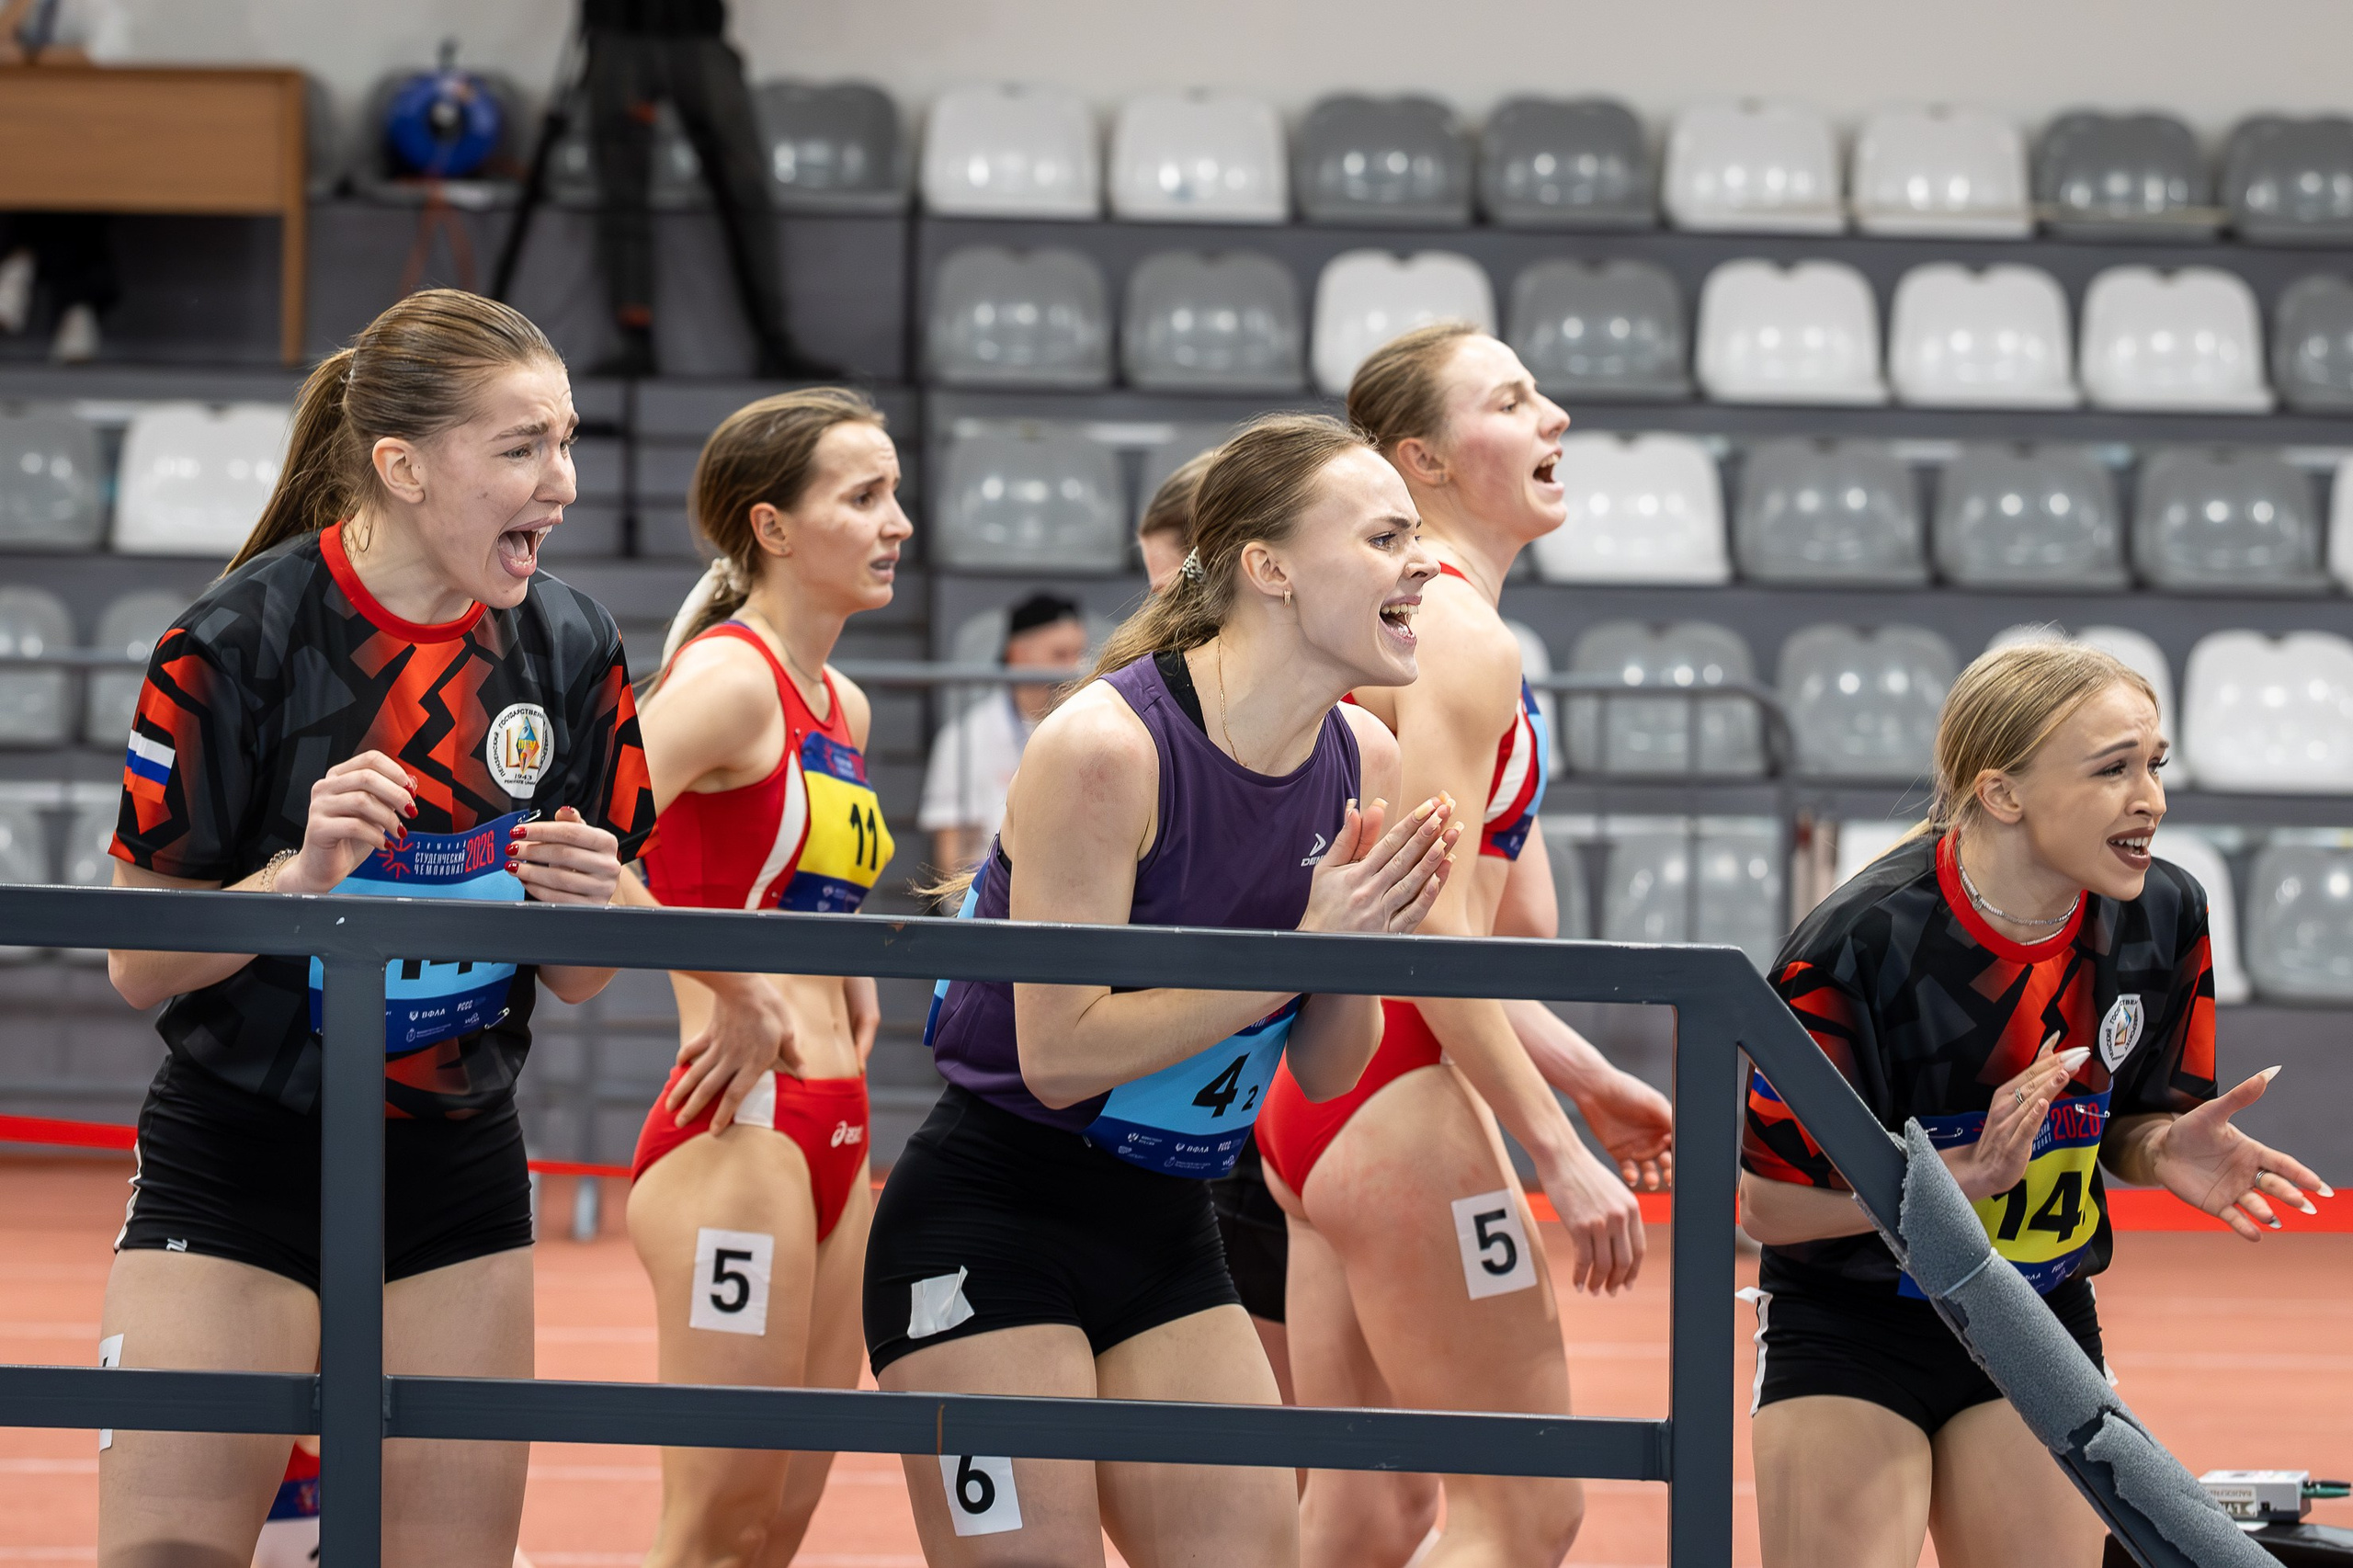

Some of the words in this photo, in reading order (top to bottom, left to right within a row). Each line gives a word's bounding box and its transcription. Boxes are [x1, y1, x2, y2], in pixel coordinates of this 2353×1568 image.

[493, 732, 506, 778] ПЕНЗЕНСКИЙ
[415, 849, 466, 864] СТУДЕНЧЕСКИЙ
[465, 829, 494, 873] 2026
[850, 802, 878, 871] 11
[414, 863, 464, 876] ЧЕМПИОНАТ
[421, 1008, 446, 1019] ВФЛА
[1191, 1051, 1251, 1119] 4
[1242, 1085, 1259, 1111] 2
[1990, 1170, 2083, 1244] 14
[1473, 1208, 1518, 1276] 5
[710, 1248, 753, 1313] 5
[956, 1455, 995, 1515] 6
